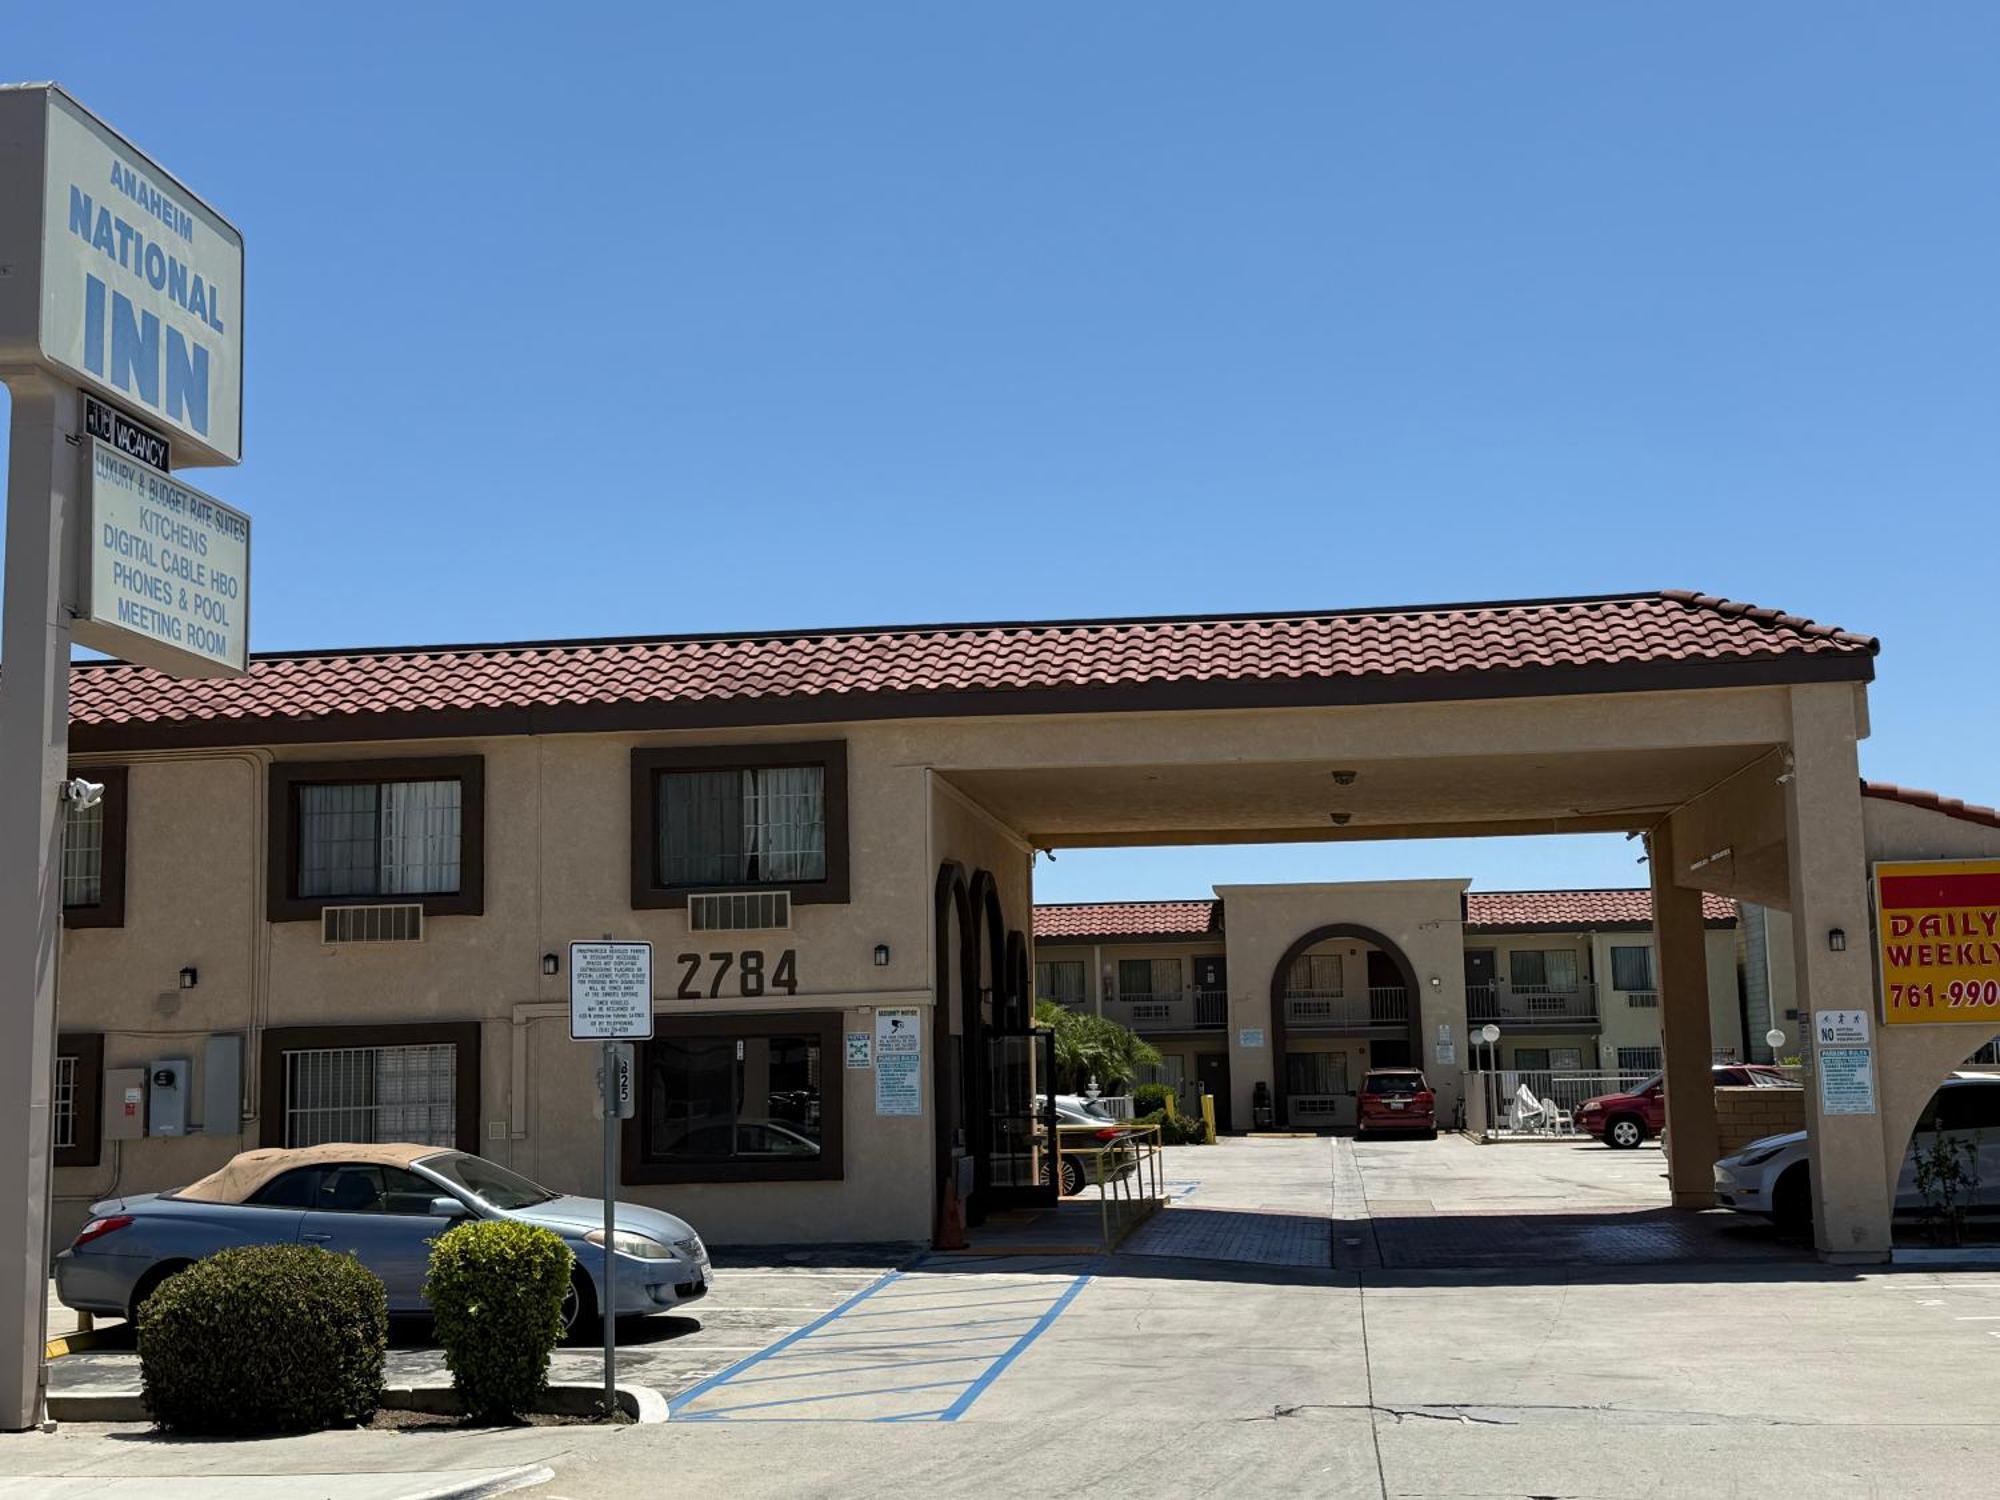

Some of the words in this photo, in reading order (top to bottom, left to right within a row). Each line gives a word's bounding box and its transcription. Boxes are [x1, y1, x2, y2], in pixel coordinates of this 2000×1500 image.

[111, 160, 192, 243] ANAHEIM
[69, 184, 224, 335] NATIONAL
[84, 272, 209, 437] INN
[115, 420, 165, 468] VACANCY
[96, 452, 136, 491] LUXURY
[138, 472, 146, 496] &
[148, 479, 188, 515] BUDGET
[190, 499, 213, 527] RATE
[215, 510, 245, 543] SUITES
[103, 523, 157, 567] DIGITAL
[161, 549, 205, 587] CABLE
[210, 569, 238, 600] HBO
[139, 506, 208, 557] KITCHENS
[113, 561, 173, 606] PHONES
[178, 588, 188, 611] &
[194, 593, 229, 627] POOL
[117, 597, 182, 641] MEETING
[186, 623, 226, 657] ROOM
[1889, 911, 1998, 938] DAILY
[677, 949, 798, 999] 2784
[1889, 978, 2000, 1009] 761-990
[1821, 1027, 1834, 1042] NO
